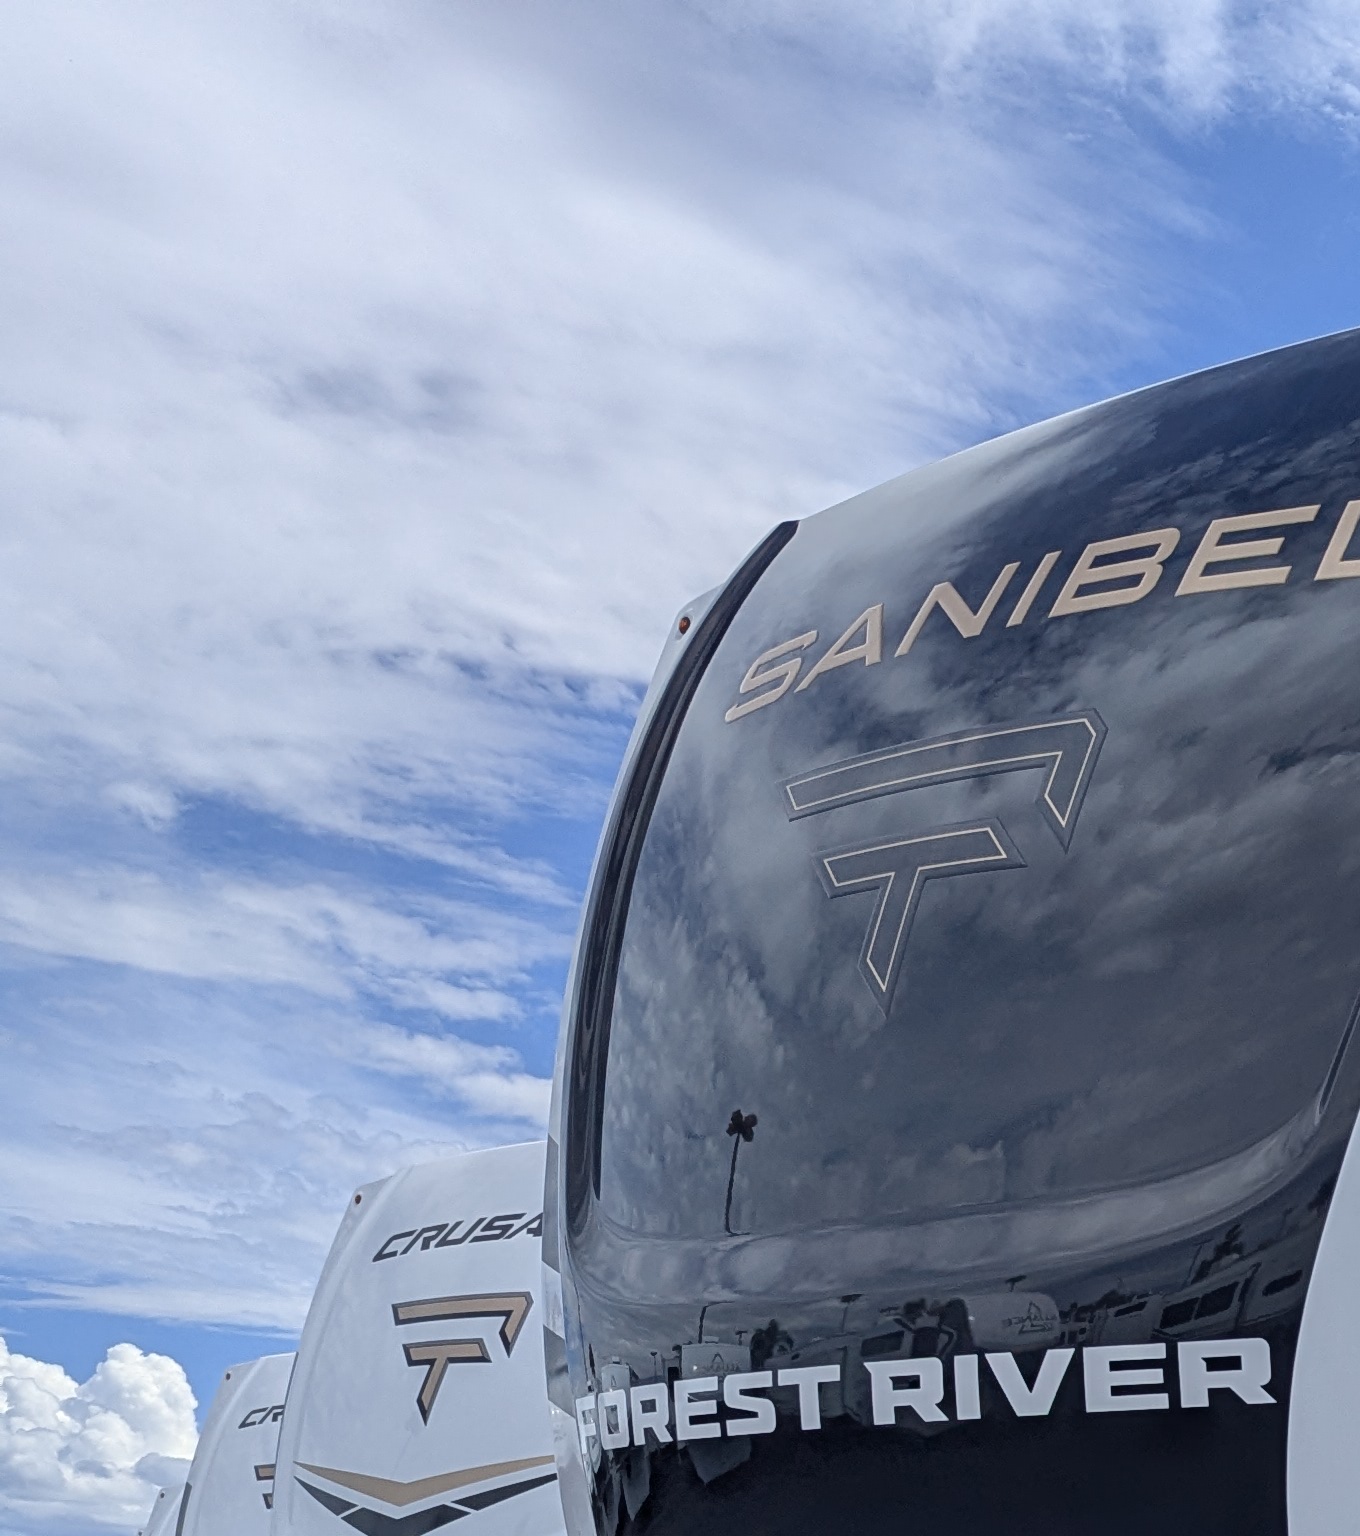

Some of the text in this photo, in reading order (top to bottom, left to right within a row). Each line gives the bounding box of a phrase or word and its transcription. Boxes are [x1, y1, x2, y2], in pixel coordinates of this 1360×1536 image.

[372, 1212, 543, 1262] CRUSA
[575, 1337, 1278, 1454] FOREST RIVER
